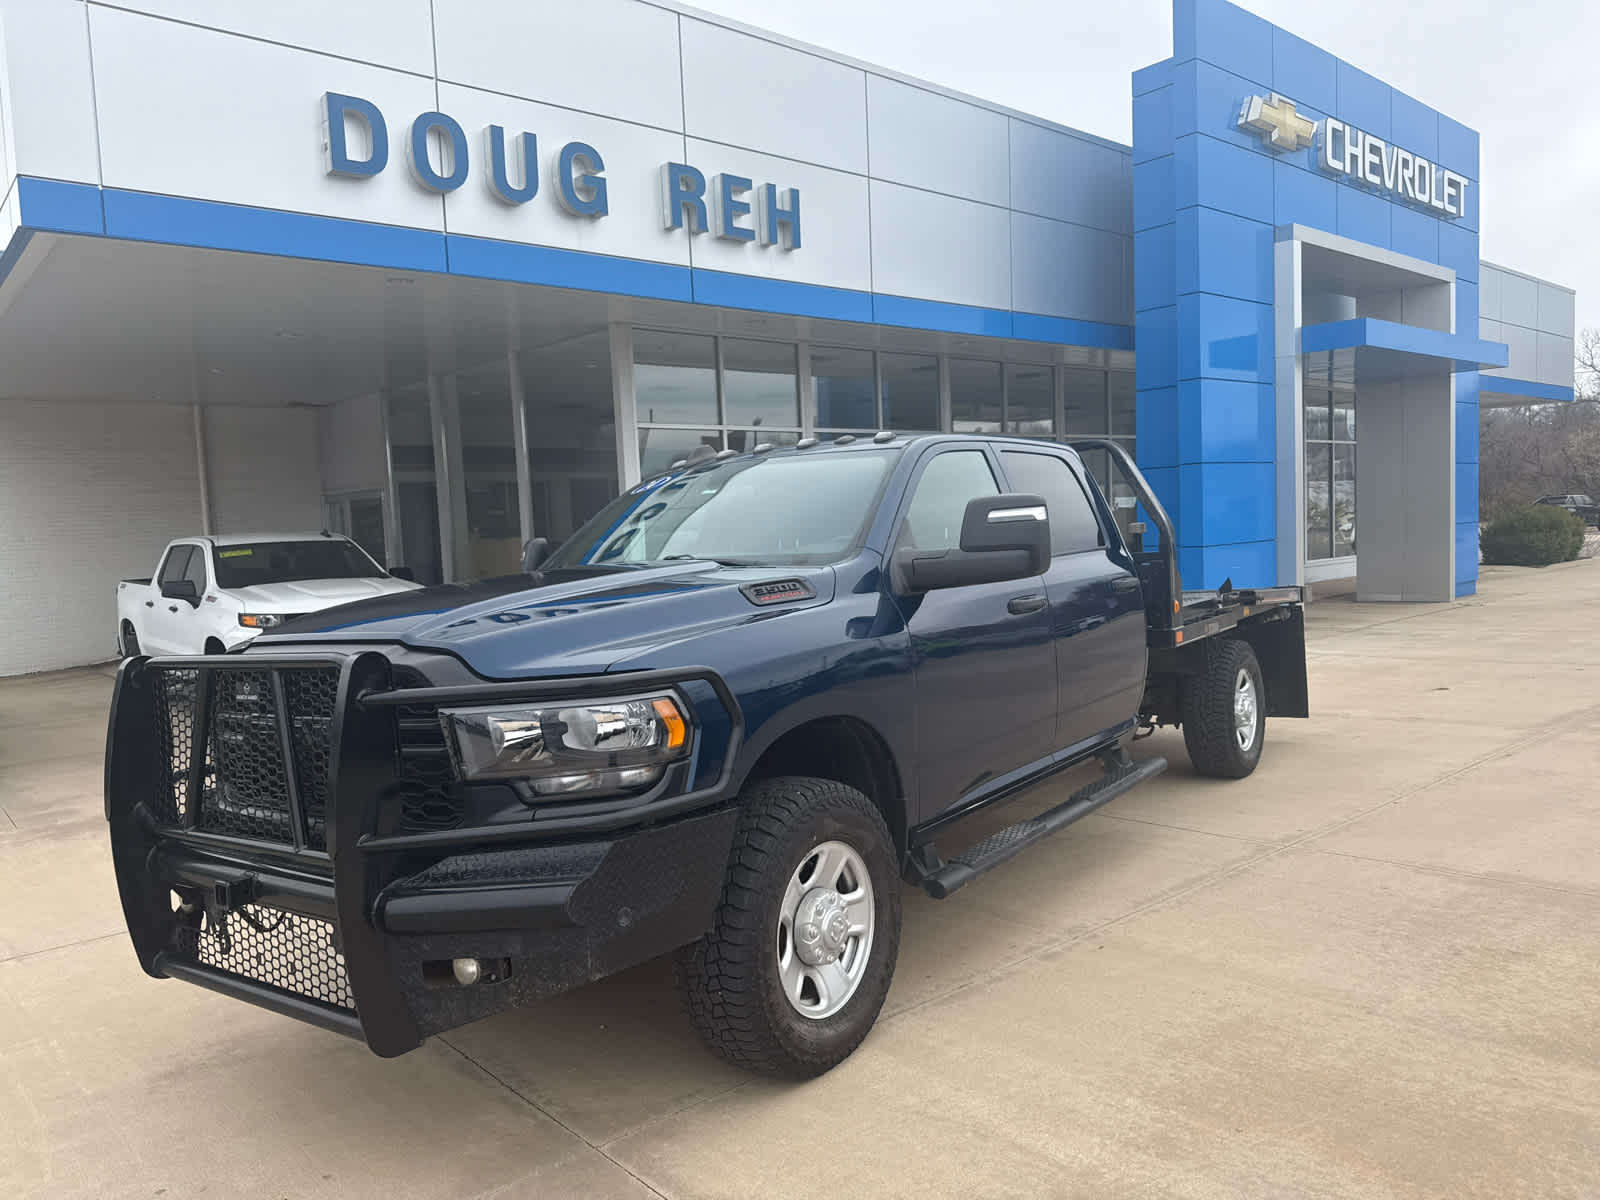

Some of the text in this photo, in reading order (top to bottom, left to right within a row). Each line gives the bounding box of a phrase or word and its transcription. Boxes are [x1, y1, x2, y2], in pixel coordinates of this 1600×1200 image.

[323, 91, 802, 250] DOUG REH
[1322, 117, 1469, 218] CHEVROLET
